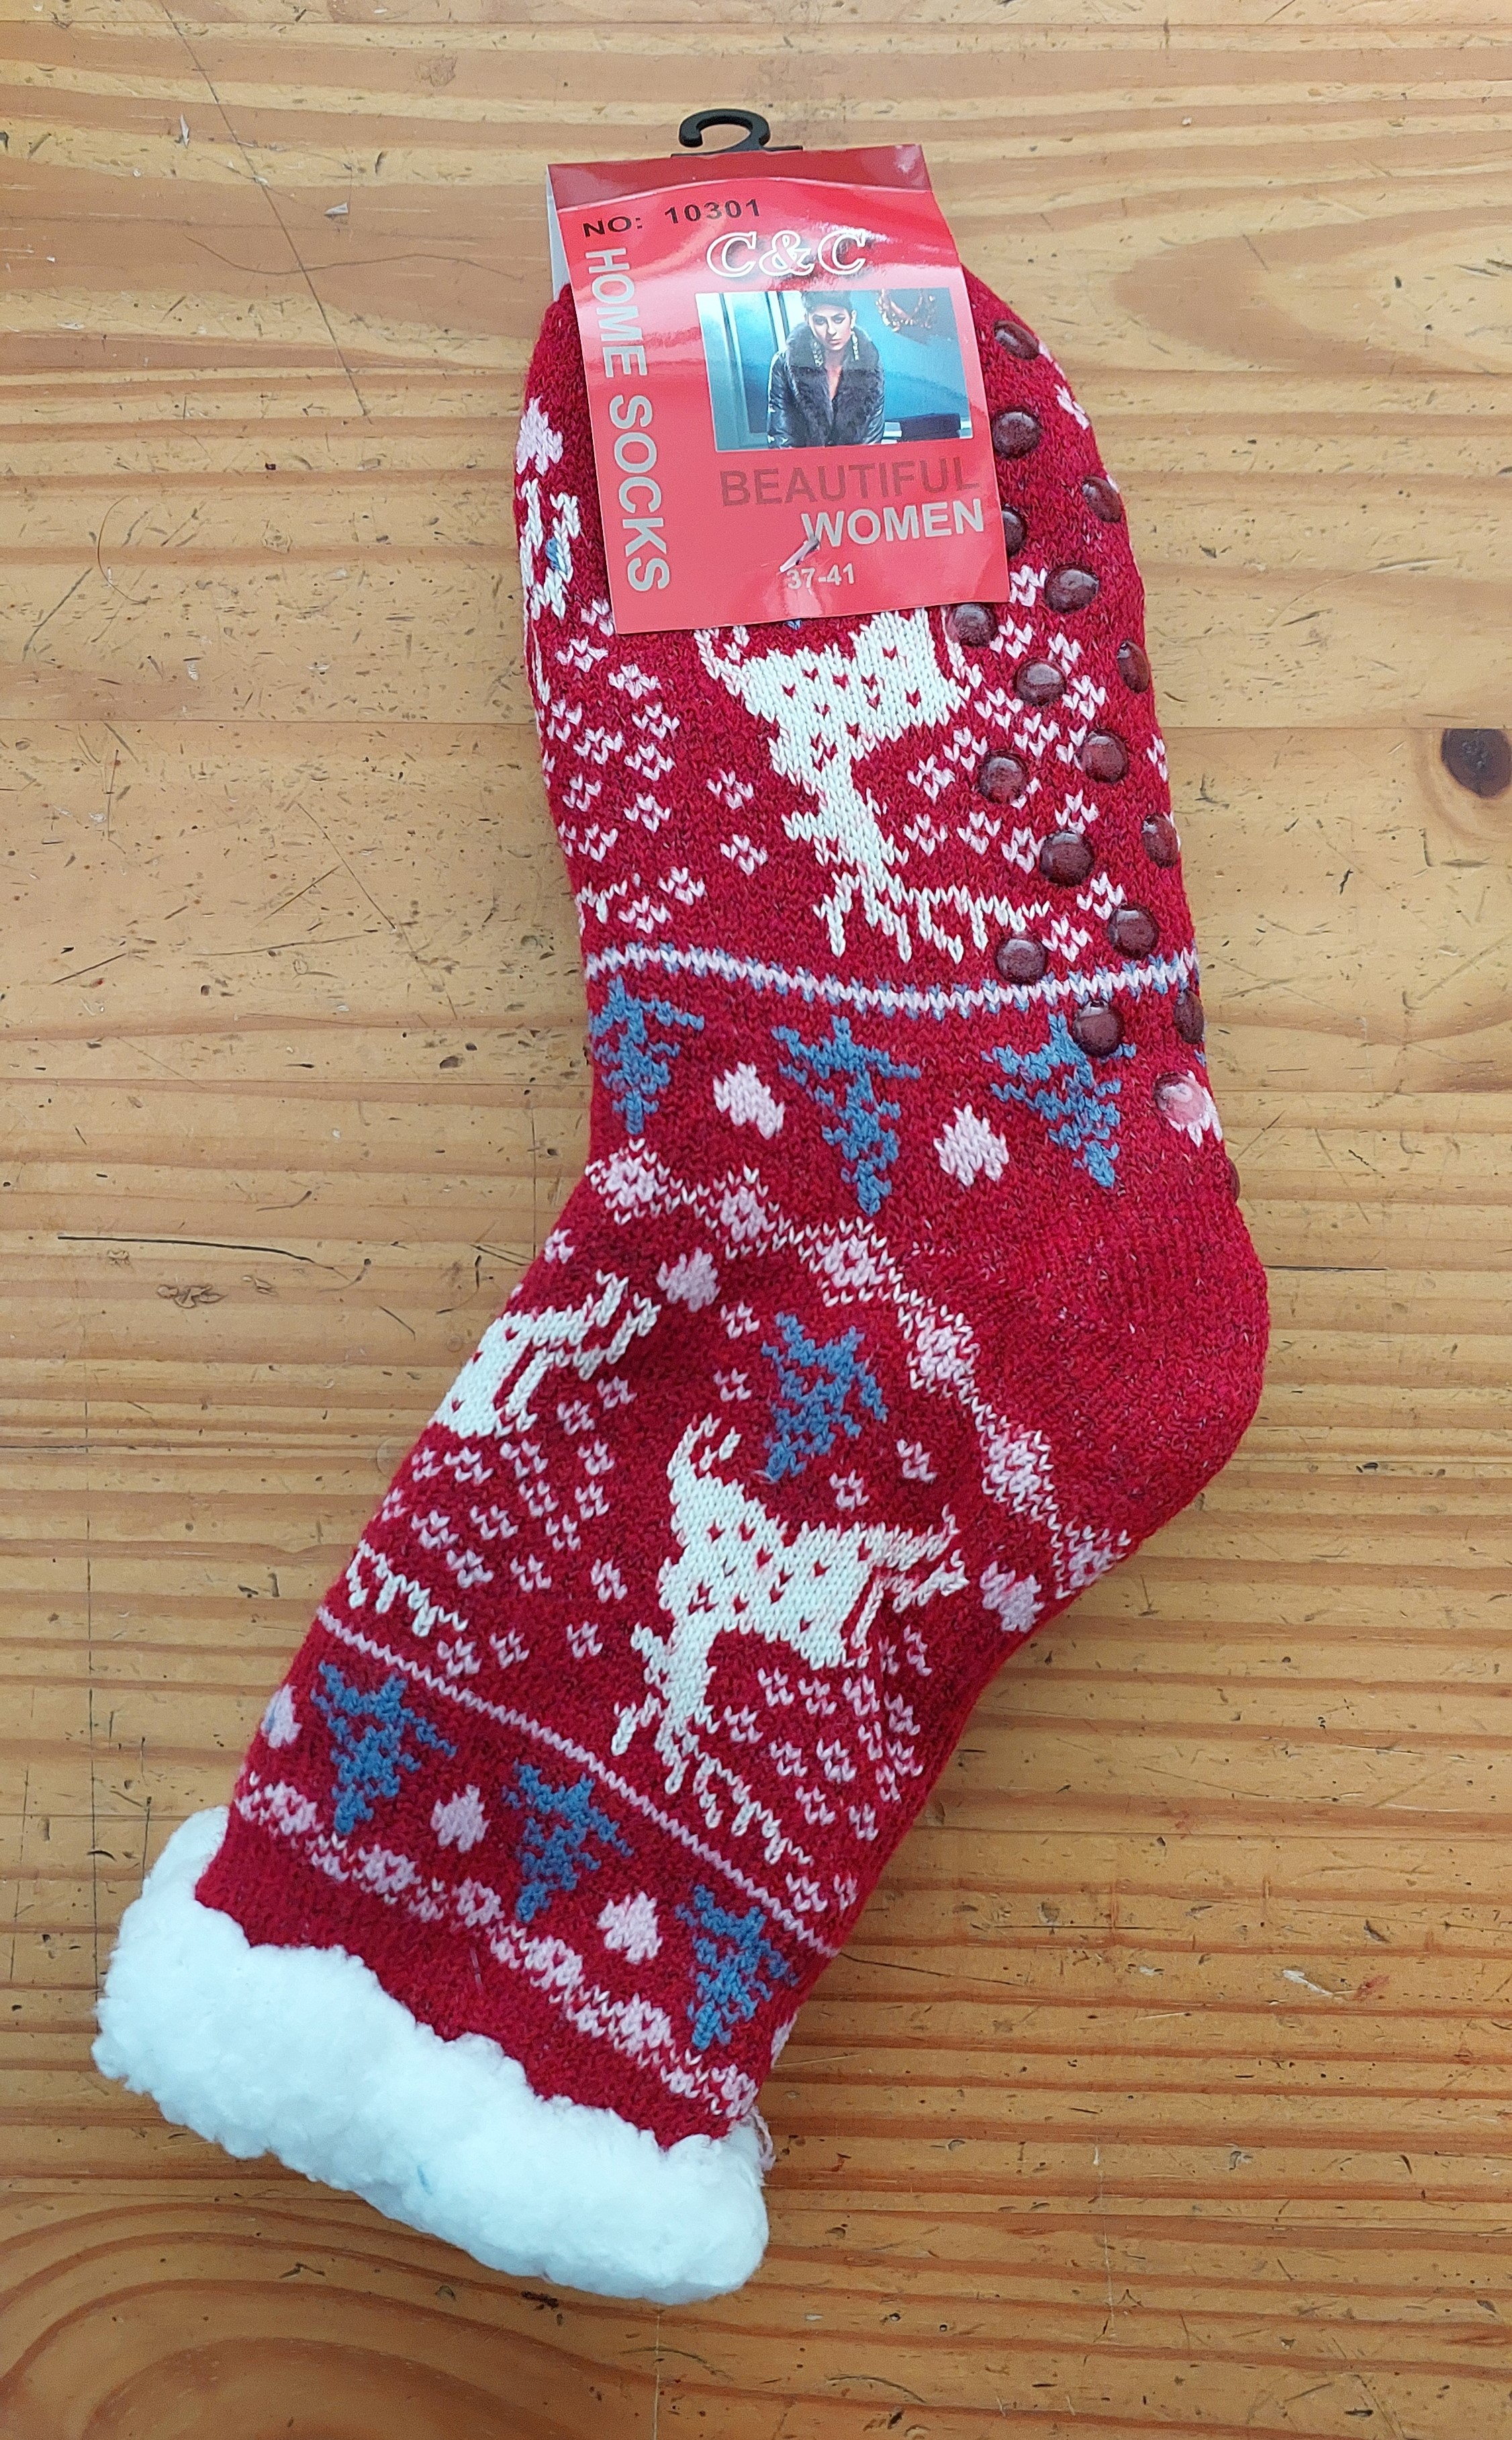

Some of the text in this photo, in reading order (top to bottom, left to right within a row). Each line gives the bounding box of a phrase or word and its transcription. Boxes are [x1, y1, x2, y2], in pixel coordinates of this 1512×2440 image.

[583, 199, 760, 237] NO: 10301
[706, 230, 867, 277] C&C
[585, 248, 669, 592] HOME SOCKS
[720, 457, 979, 506] BEAUTIFUL
[801, 498, 984, 547] WOMEN
[786, 563, 855, 590] 37-41
